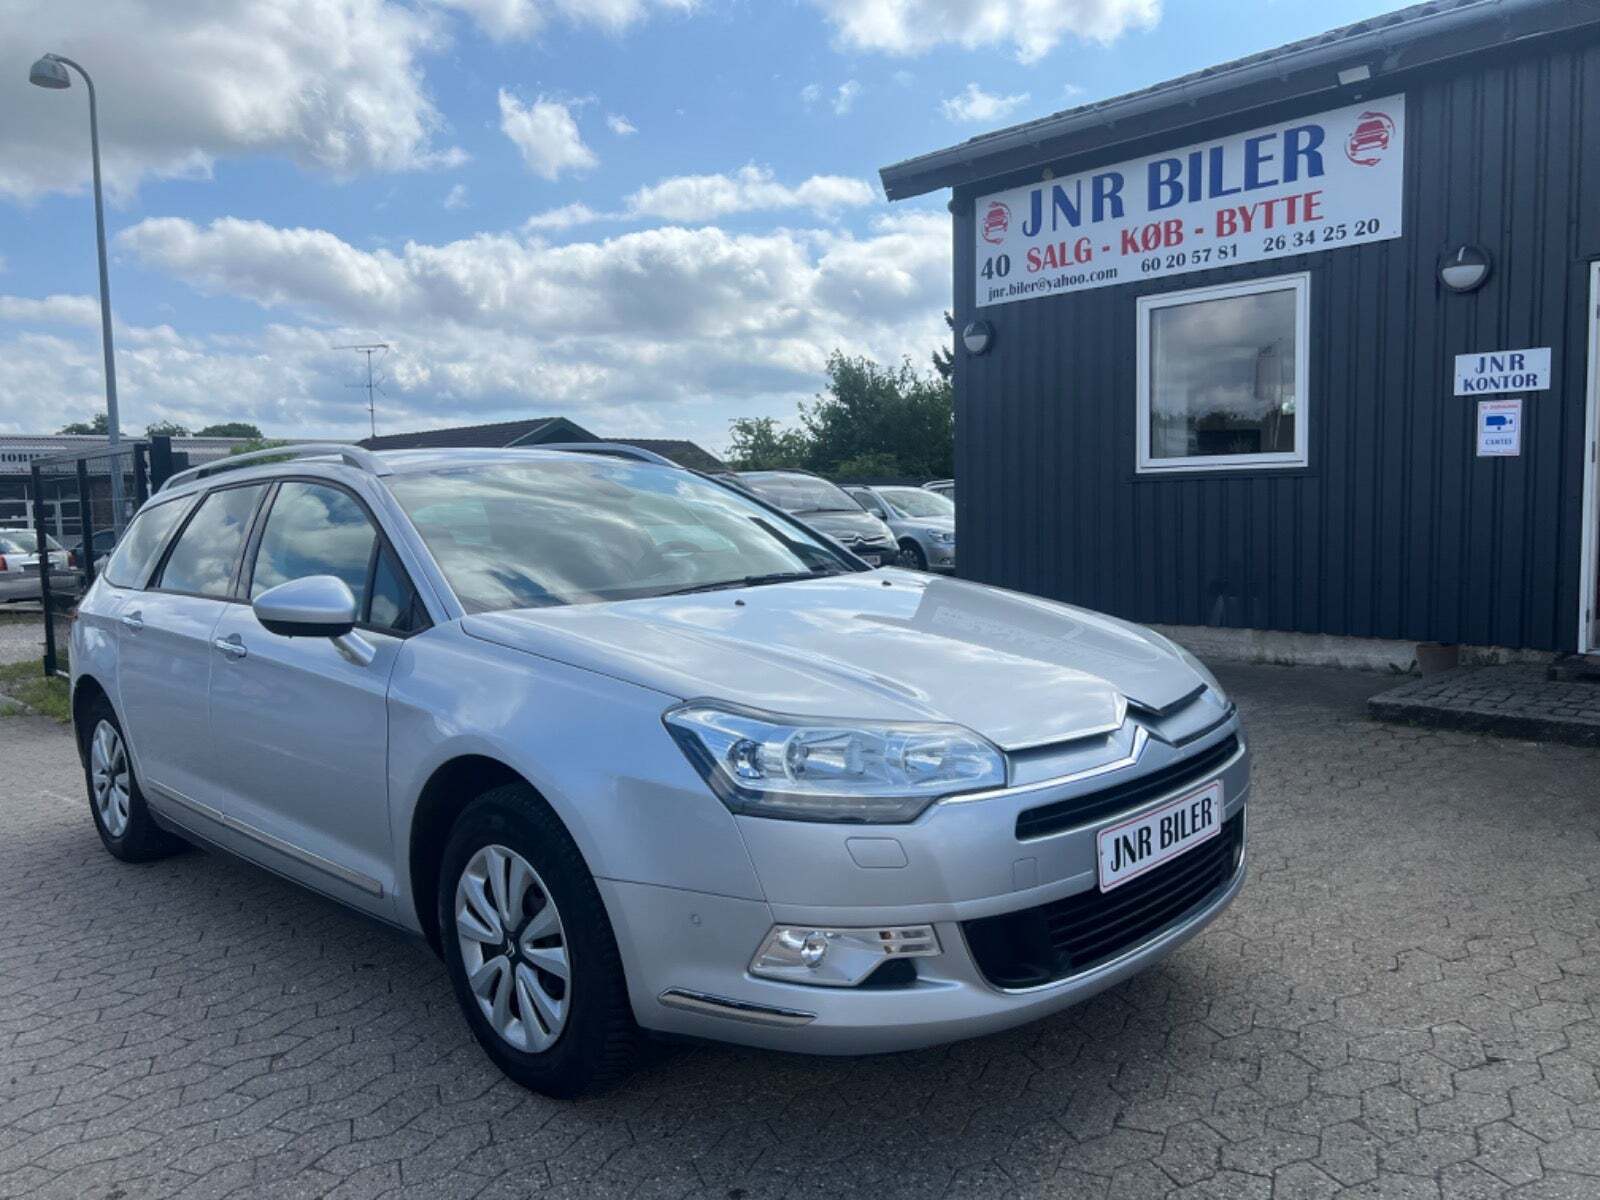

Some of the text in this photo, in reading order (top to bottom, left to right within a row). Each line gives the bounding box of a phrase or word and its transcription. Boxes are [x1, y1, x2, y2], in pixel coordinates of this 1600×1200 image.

[1022, 124, 1325, 238] JNR BILER
[1026, 237, 1092, 274] SALG
[1121, 219, 1183, 256] KØB
[1216, 190, 1324, 238] BYTTE
[1263, 218, 1380, 253] 26 34 25 20
[981, 254, 1010, 280] 40
[1141, 244, 1238, 274] 60 20 57 81
[988, 265, 1118, 302] jnr.biler@yahoo.com
[1475, 354, 1524, 374] JNR
[1463, 374, 1538, 392] KONTOR
[1111, 798, 1211, 872] JNR BILER
